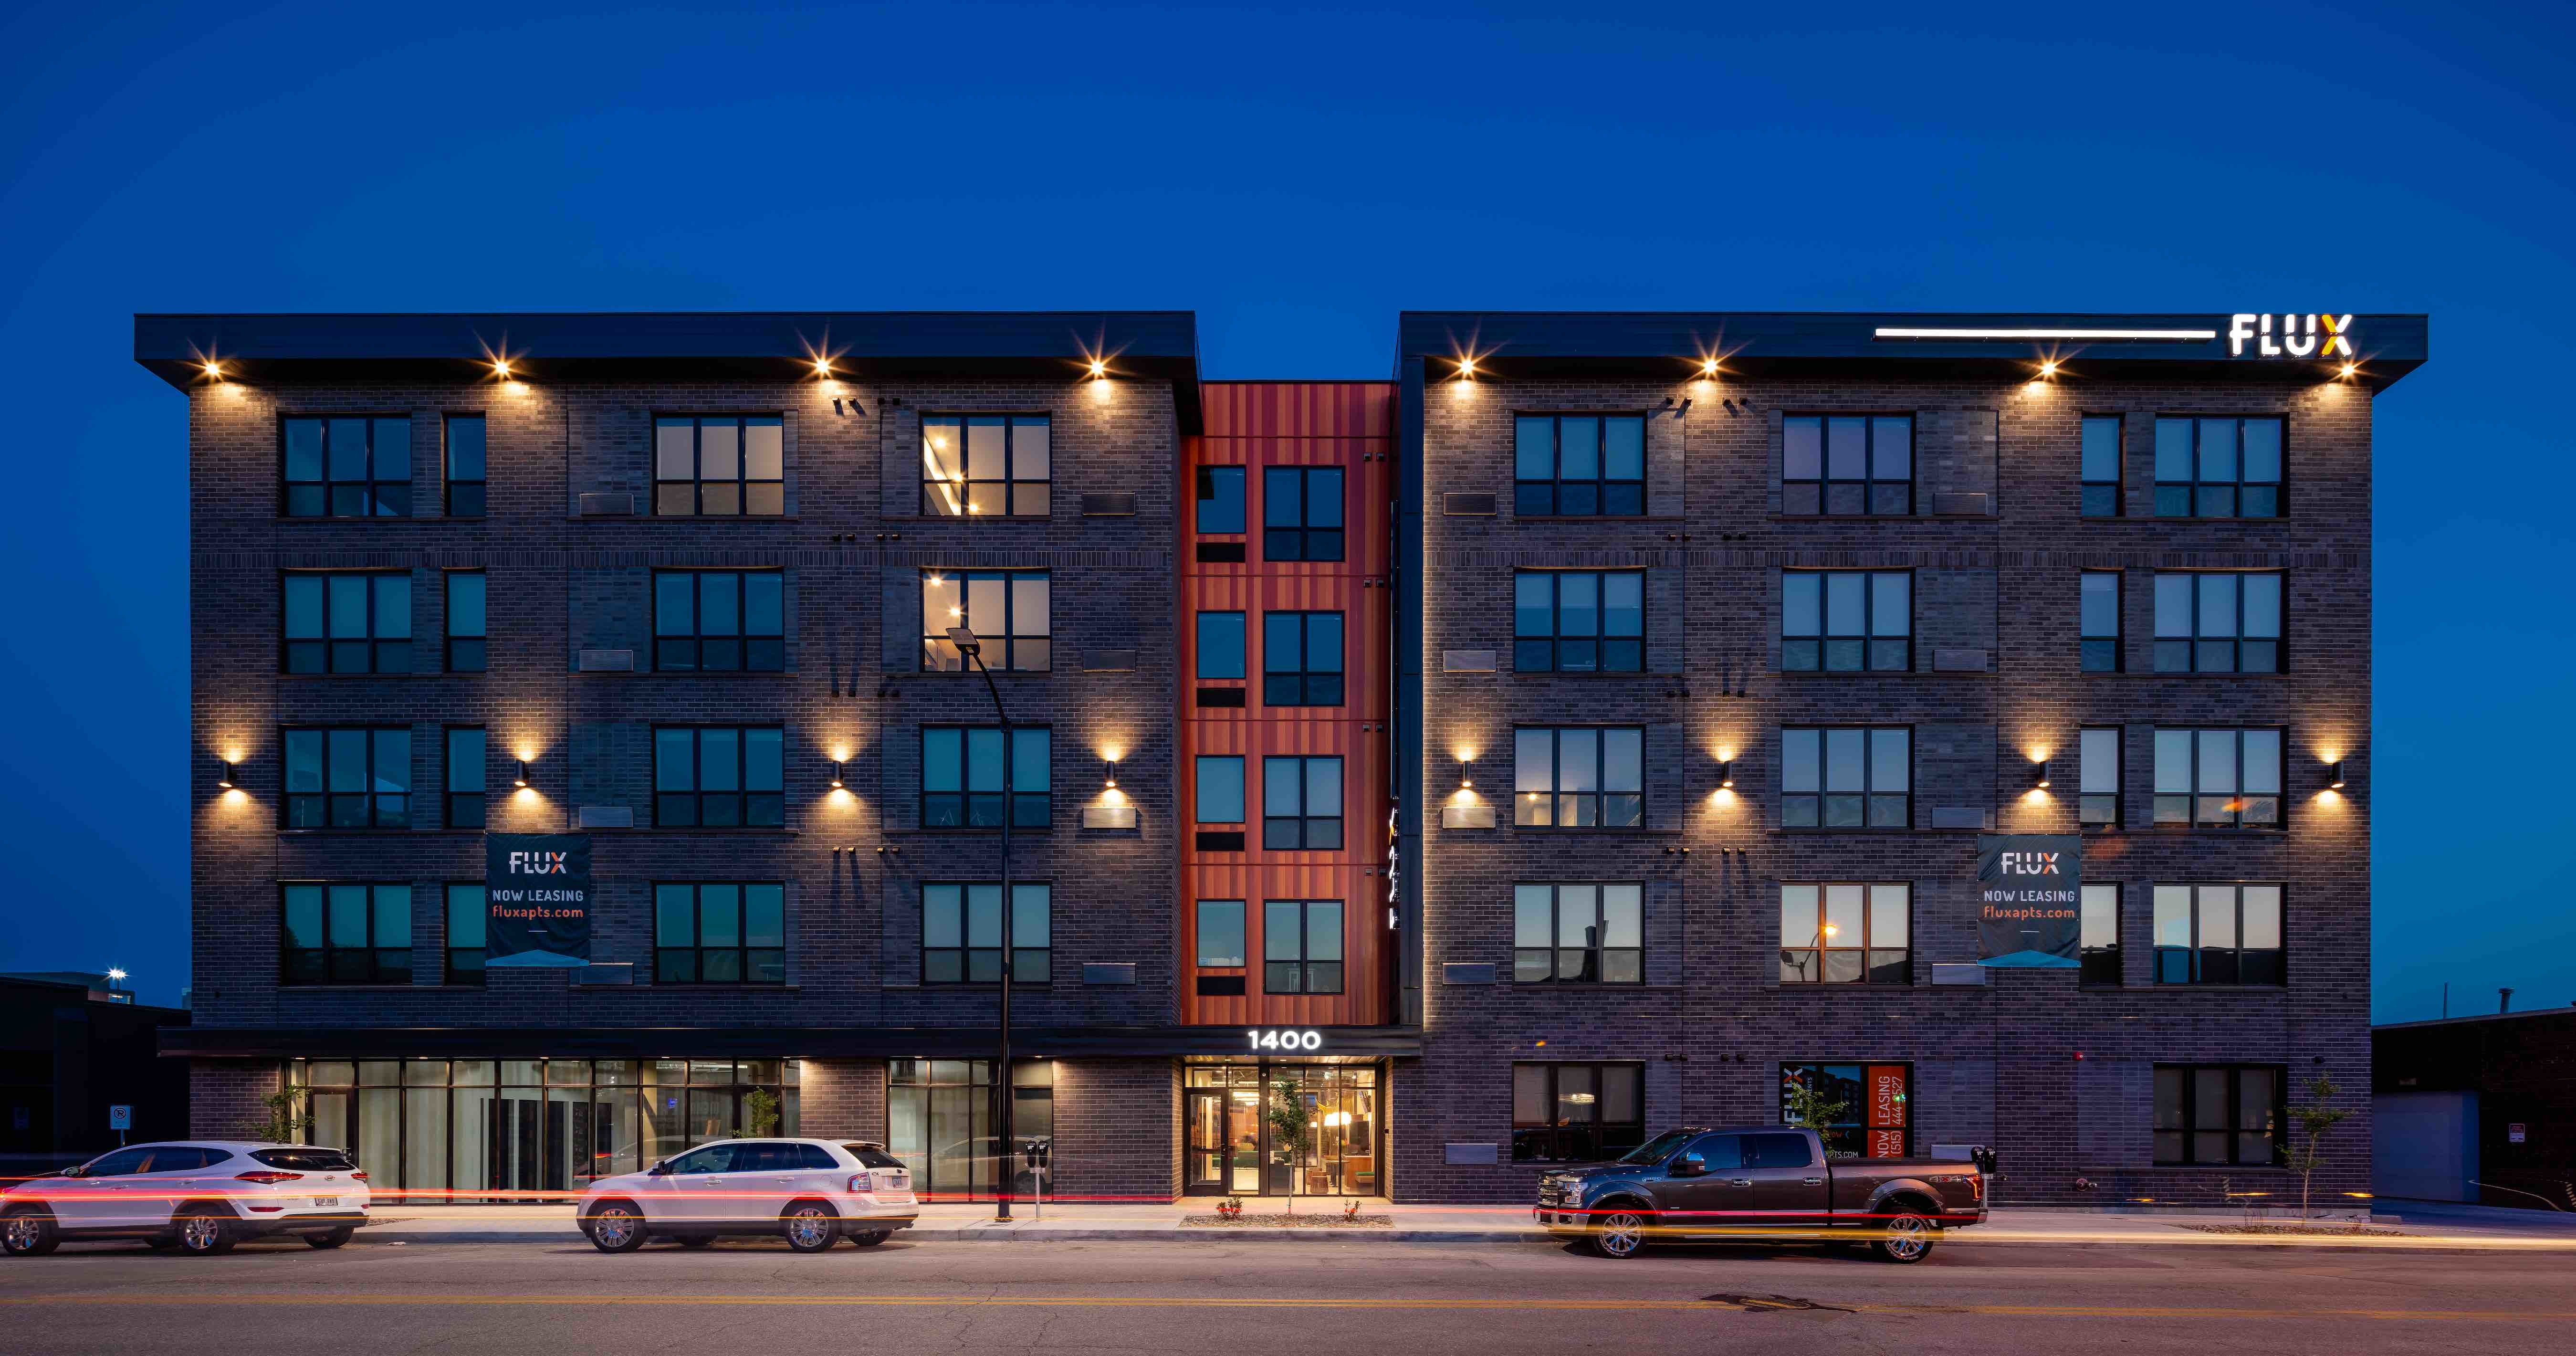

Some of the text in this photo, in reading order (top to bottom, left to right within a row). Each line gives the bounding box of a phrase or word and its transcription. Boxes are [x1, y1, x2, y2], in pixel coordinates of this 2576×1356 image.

[2230, 314, 2352, 355] FLUX
[509, 852, 566, 874] FLUX
[2001, 852, 2059, 874] FLUX
[493, 890, 583, 901] NOW LEASING
[1984, 891, 2074, 902] NOW LEASING
[493, 905, 583, 920] fluxapts.com
[1984, 906, 2075, 920] fluxapts.com
[1248, 1030, 1320, 1050] 1400
[1877, 1076, 1890, 1158] NOW LEASING
[1891, 1076, 1903, 1154] (515) 444-527
